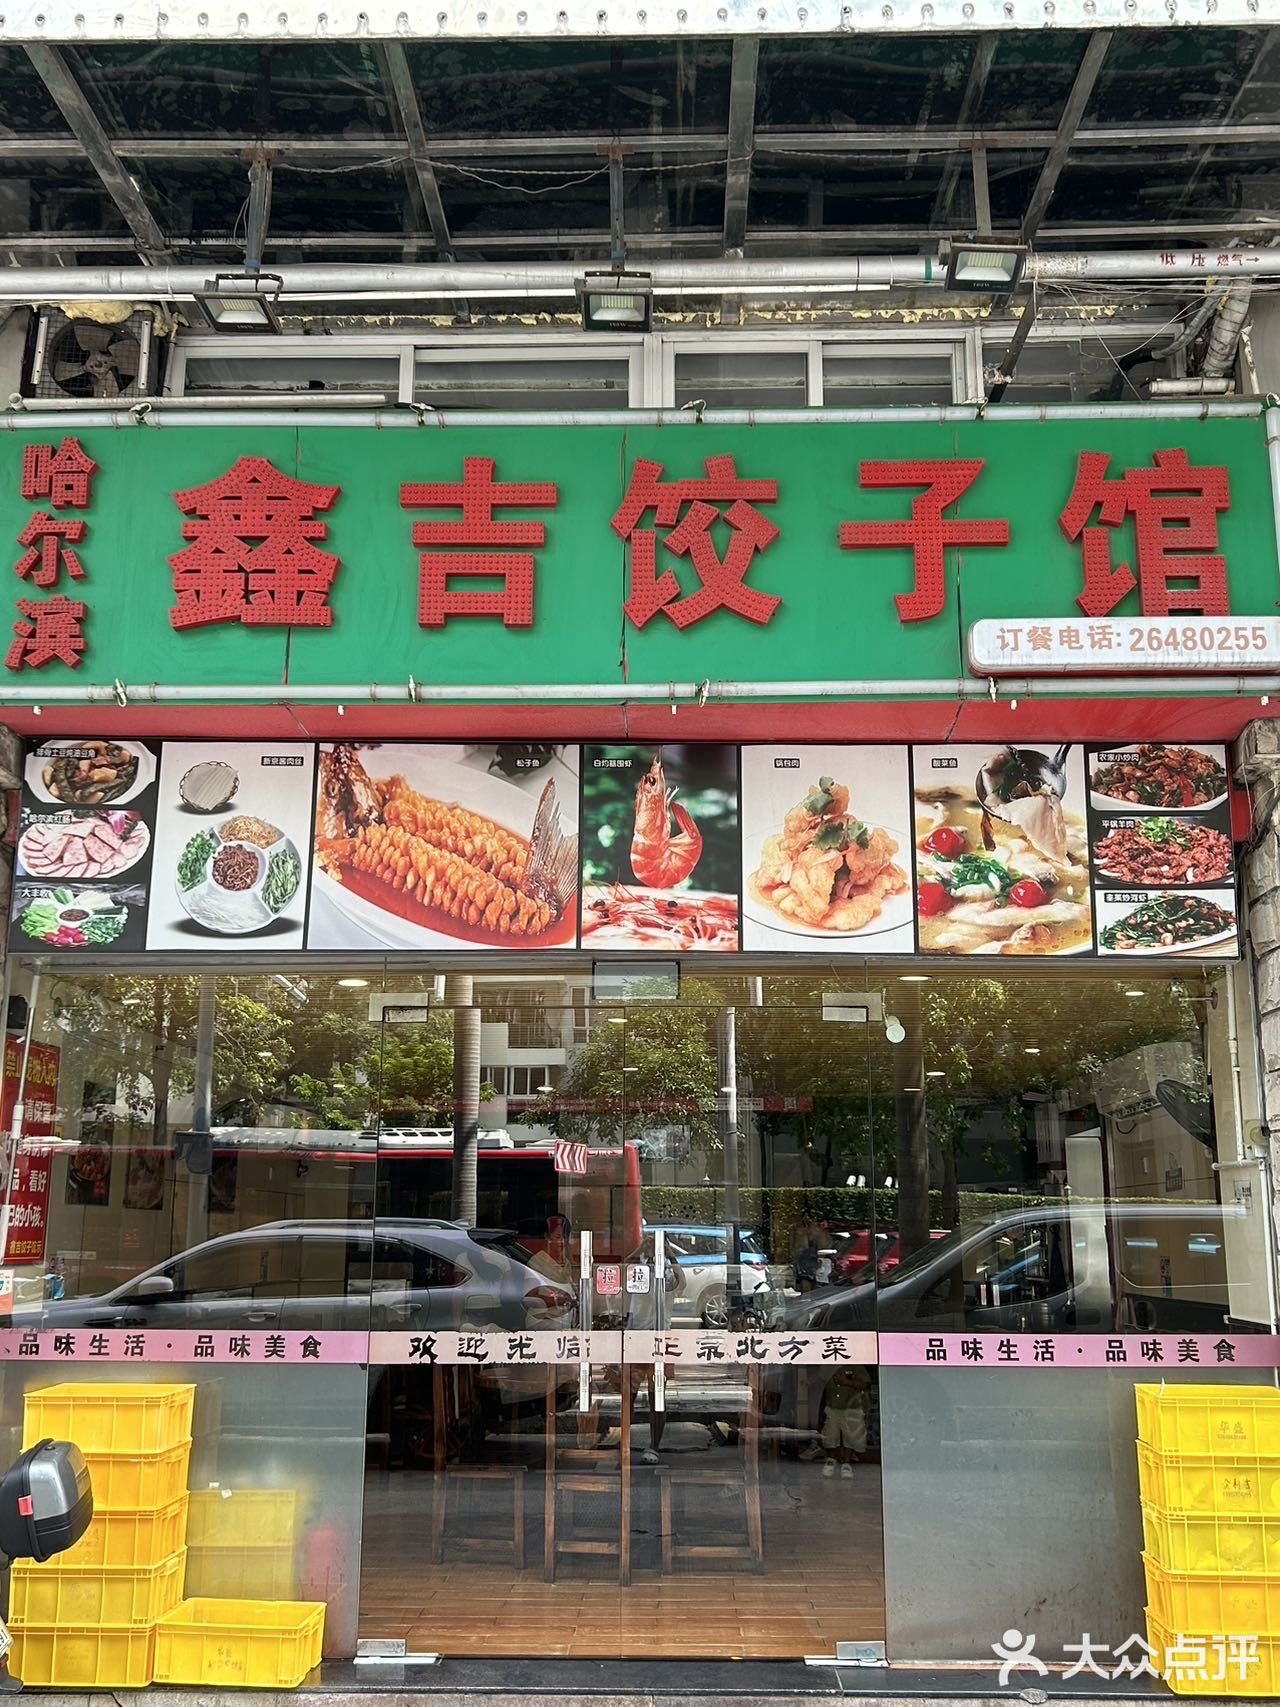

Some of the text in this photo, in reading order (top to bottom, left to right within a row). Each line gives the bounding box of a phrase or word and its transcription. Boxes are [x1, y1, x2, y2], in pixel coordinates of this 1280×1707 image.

[1160, 252, 1243, 267] 低压燃气
[4, 436, 99, 670] 哈尔滨
[166, 448, 1231, 632] 鑫吉饺子馆
[926, 1338, 1237, 1363] 品味生活·品味美食
